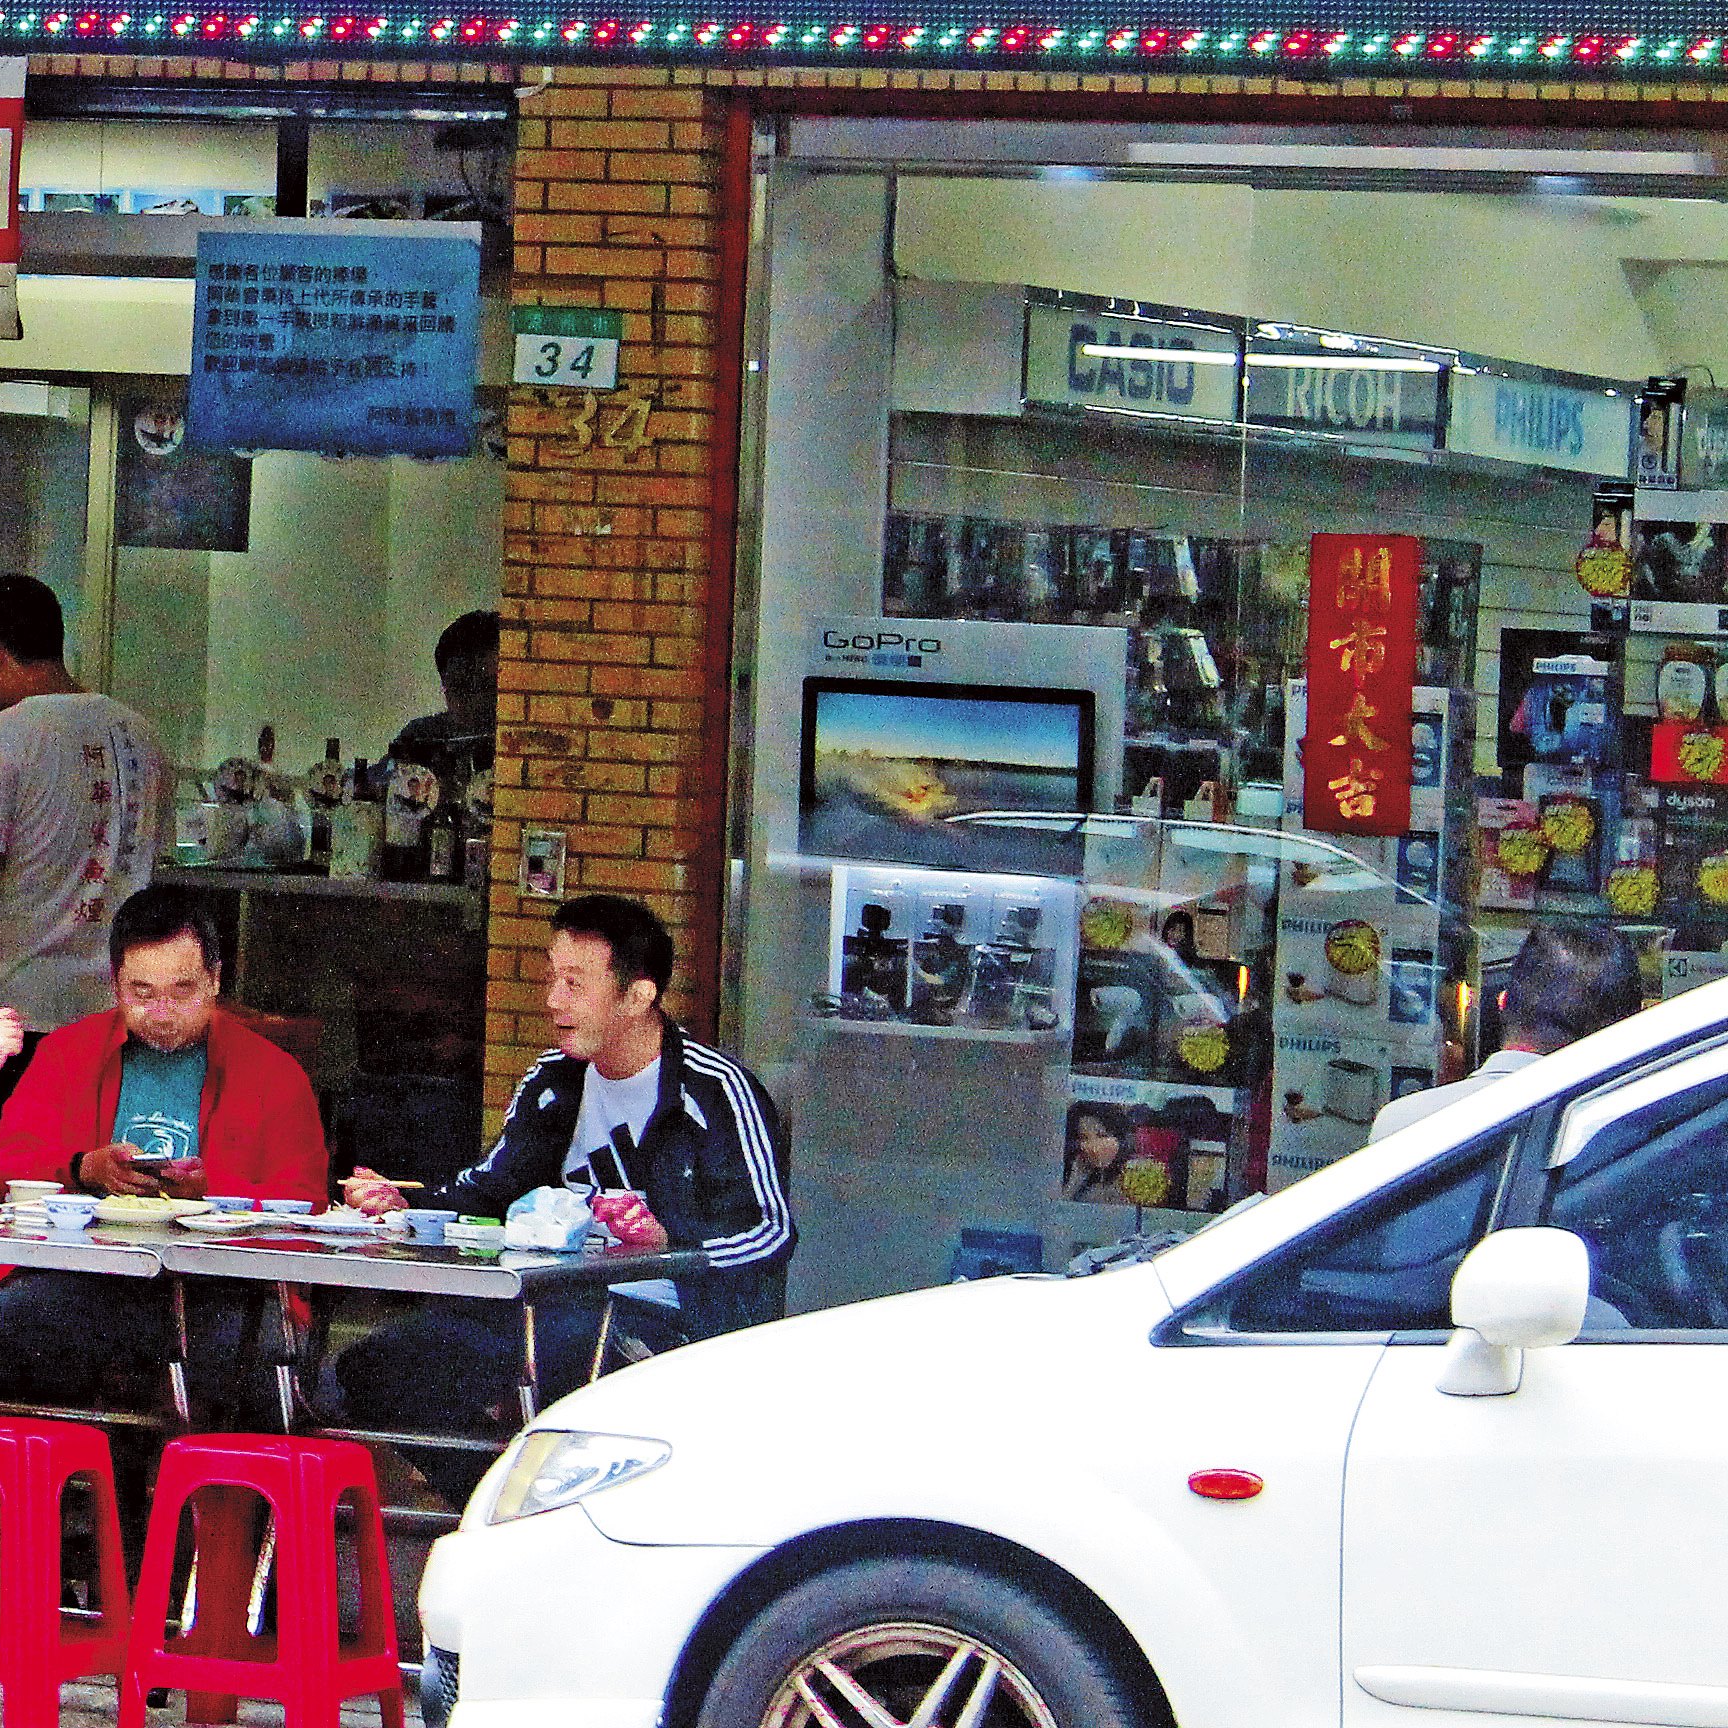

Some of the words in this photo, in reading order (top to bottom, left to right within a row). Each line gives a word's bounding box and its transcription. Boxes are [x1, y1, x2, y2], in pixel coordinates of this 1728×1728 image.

[534, 341, 595, 380] 34
[1068, 323, 1195, 405] CASIO
[1287, 360, 1402, 430] RICOH
[1494, 383, 1586, 455] PHILIPS
[823, 630, 942, 653] GoPro
[1328, 546, 1394, 819] 開市大吉
[1665, 791, 1716, 810] dyson
[1281, 918, 1337, 934] PHILIP
